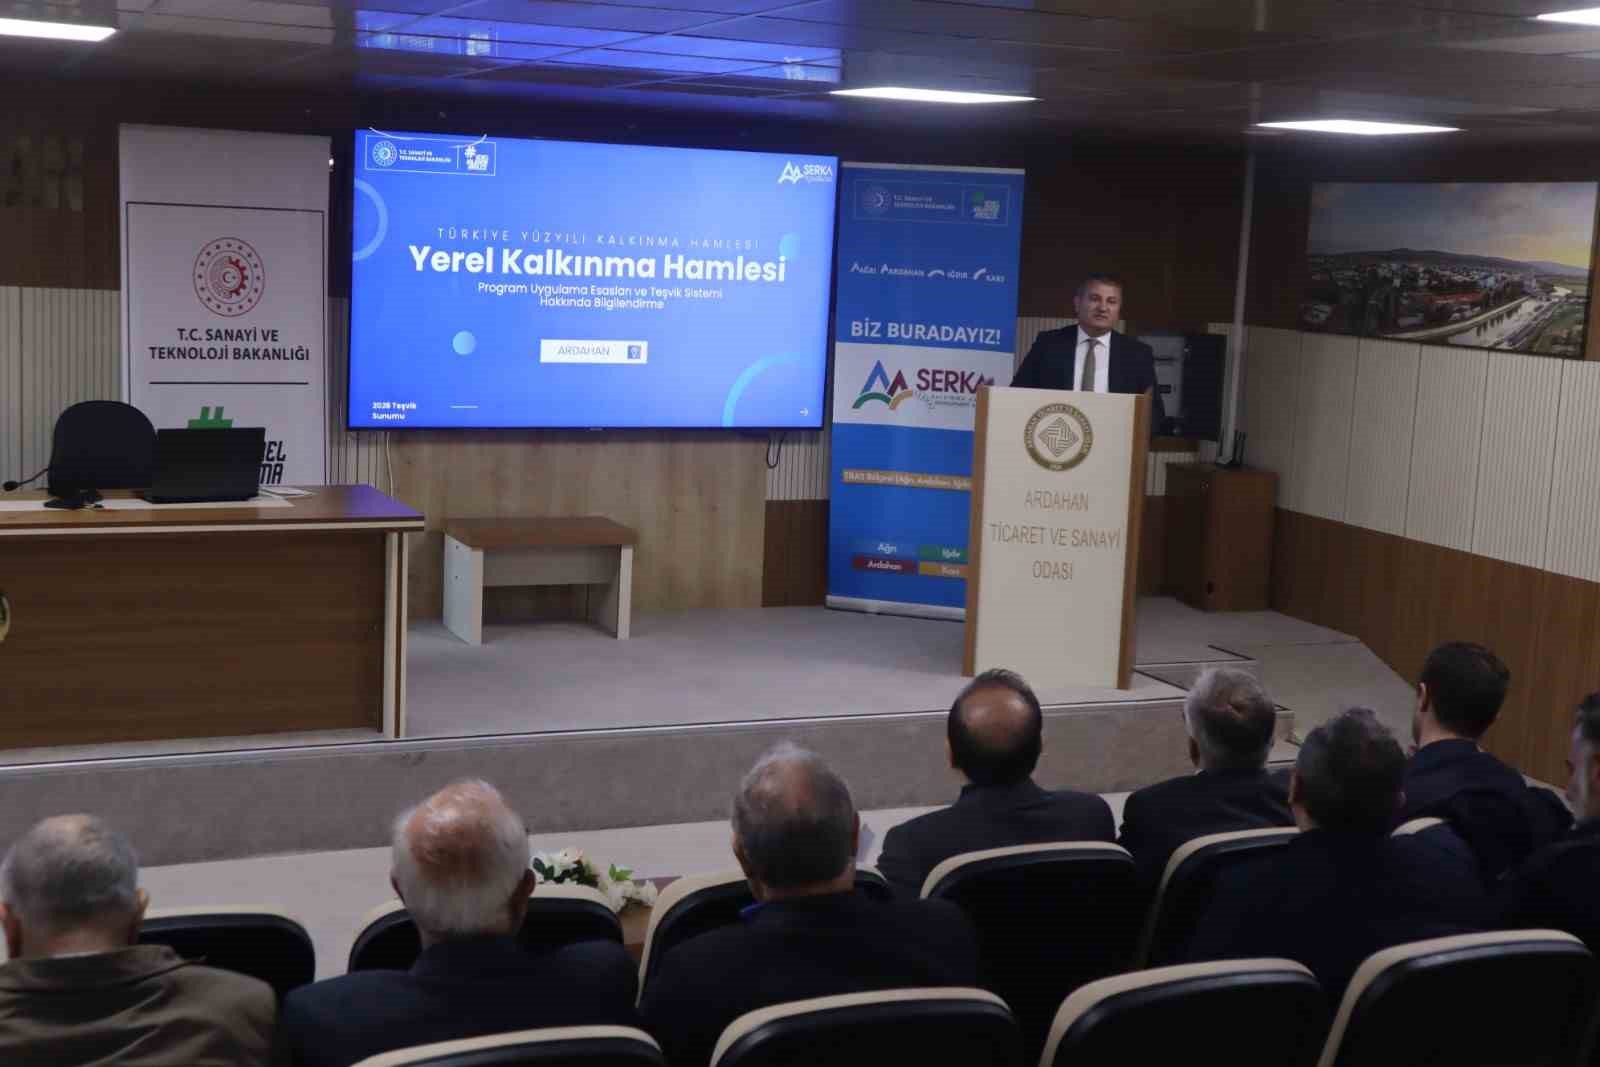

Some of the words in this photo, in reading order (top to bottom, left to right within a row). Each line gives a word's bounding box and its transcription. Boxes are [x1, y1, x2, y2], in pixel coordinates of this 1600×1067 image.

[802, 163, 833, 177] SERKA
[596, 234, 680, 247] KALKINMA
[408, 244, 493, 273] Yerel
[502, 248, 656, 278] Kalkınma
[663, 254, 786, 282] Hamlesi
[478, 282, 528, 296] Program
[531, 284, 588, 297] Uygulama
[634, 287, 647, 297] ve
[650, 286, 682, 299] Teşvik
[684, 287, 723, 299] Sistemi
[540, 295, 592, 308] Hakkında
[594, 296, 665, 310] Bilgilendirme
[177, 328, 202, 342] T.C.
[205, 326, 257, 342] SANAYİ
[261, 329, 279, 343] VE
[851, 317, 882, 338] BİZ
[887, 322, 1001, 345] BURADAYIZ!
[149, 344, 229, 361] TEKNOLOJİ
[233, 344, 310, 362] BAKANLIĞI
[558, 344, 611, 356] ARDAHAN
[372, 412, 406, 420] Sunumu
[263, 440, 286, 462] EL
[1024, 489, 1090, 512] ARDAHAN
[990, 521, 1046, 545] TİCARET
[1050, 527, 1069, 546] VE
[1071, 526, 1122, 549] SANAYİ
[867, 560, 903, 571] Ardahan
[1032, 560, 1074, 581] ODASI
